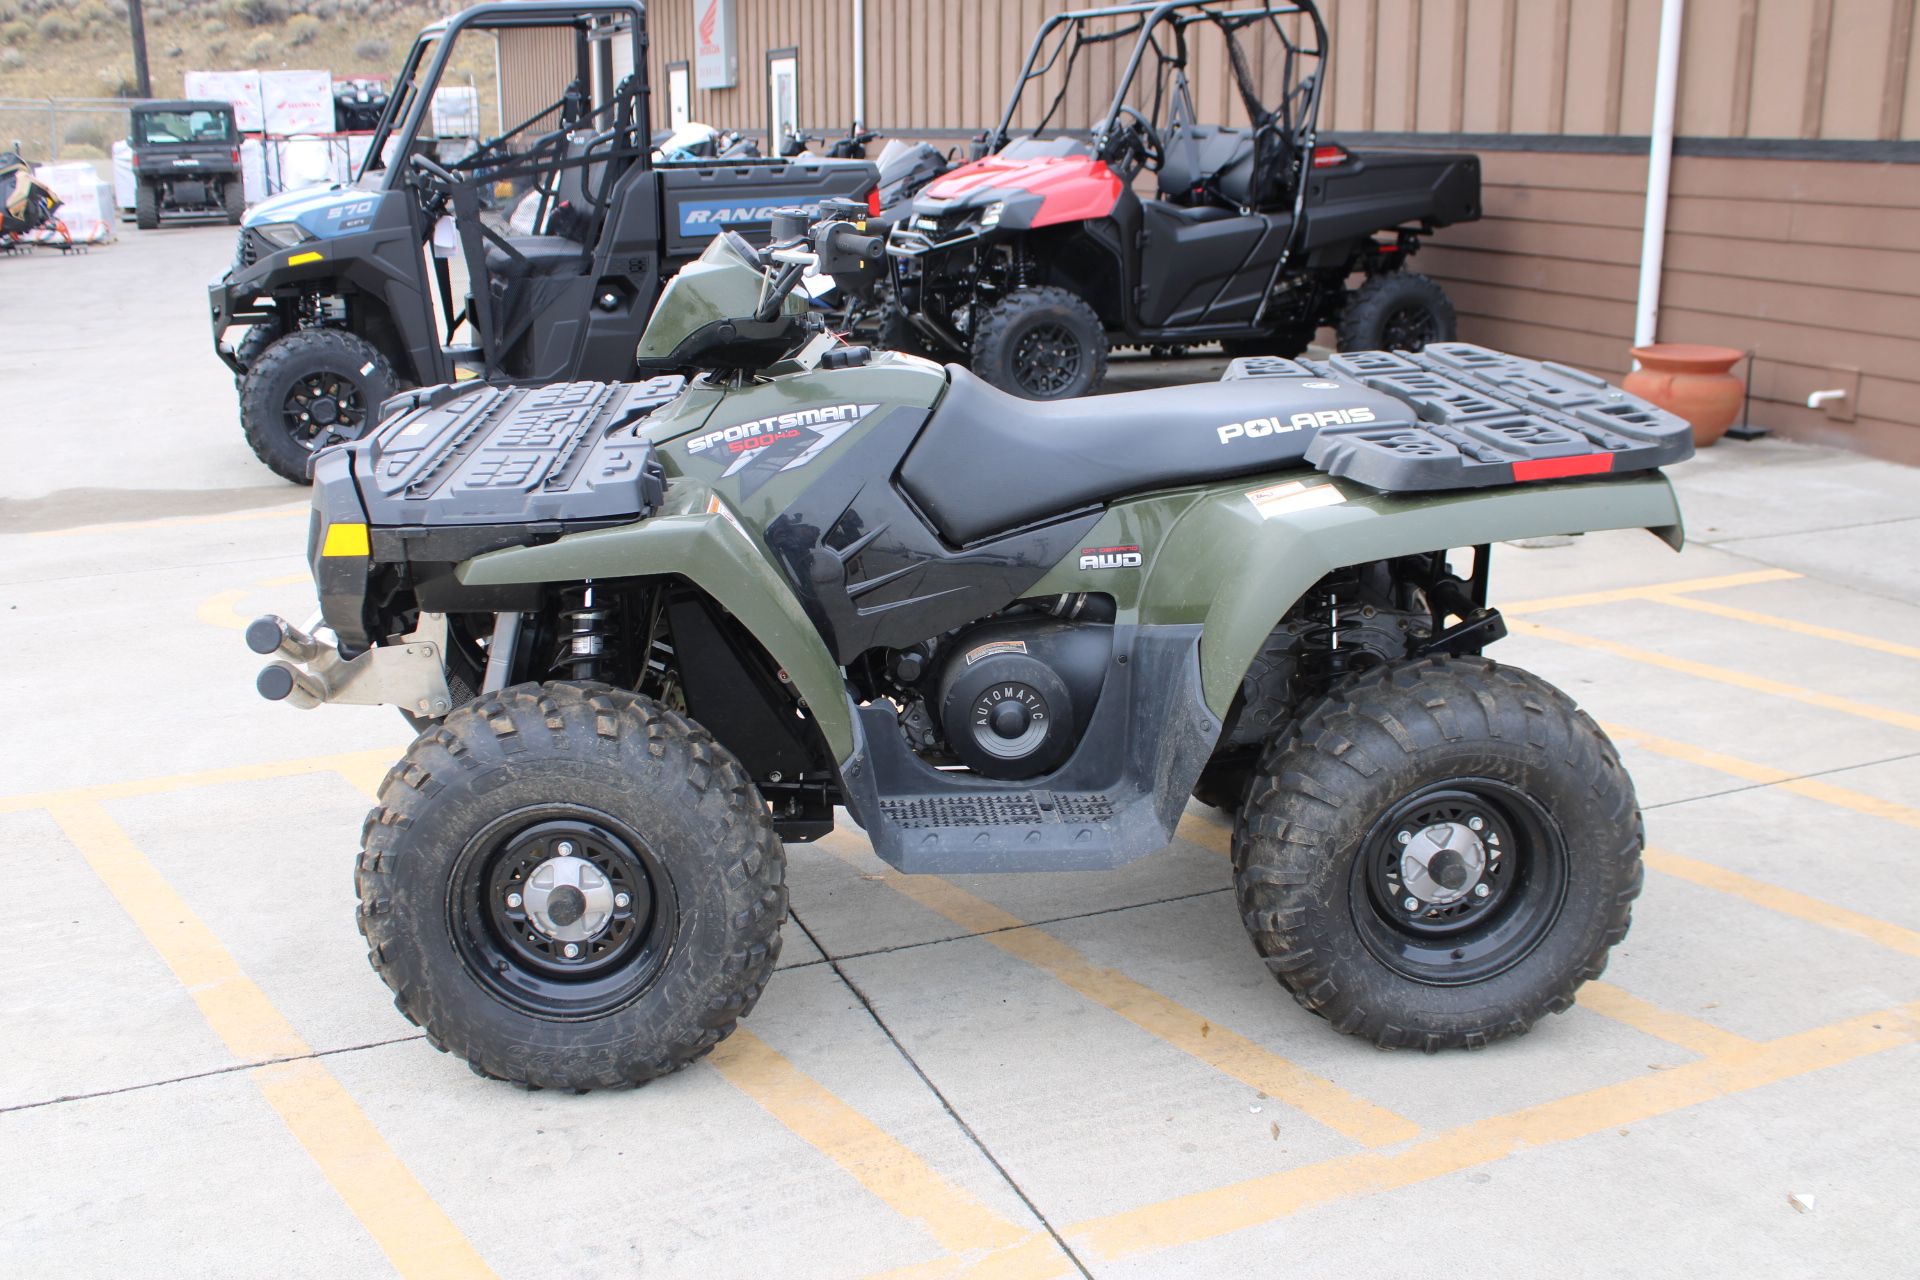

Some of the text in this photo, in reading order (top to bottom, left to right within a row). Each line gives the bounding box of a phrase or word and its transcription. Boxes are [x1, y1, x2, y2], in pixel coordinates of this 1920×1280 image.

[327, 201, 373, 220] 570
[687, 404, 858, 454] SPORTSMAN
[1216, 407, 1376, 445] POLARIS
[728, 434, 774, 453] 500
[1080, 552, 1142, 570] AWD
[977, 687, 1044, 725] AUTOMATIC
